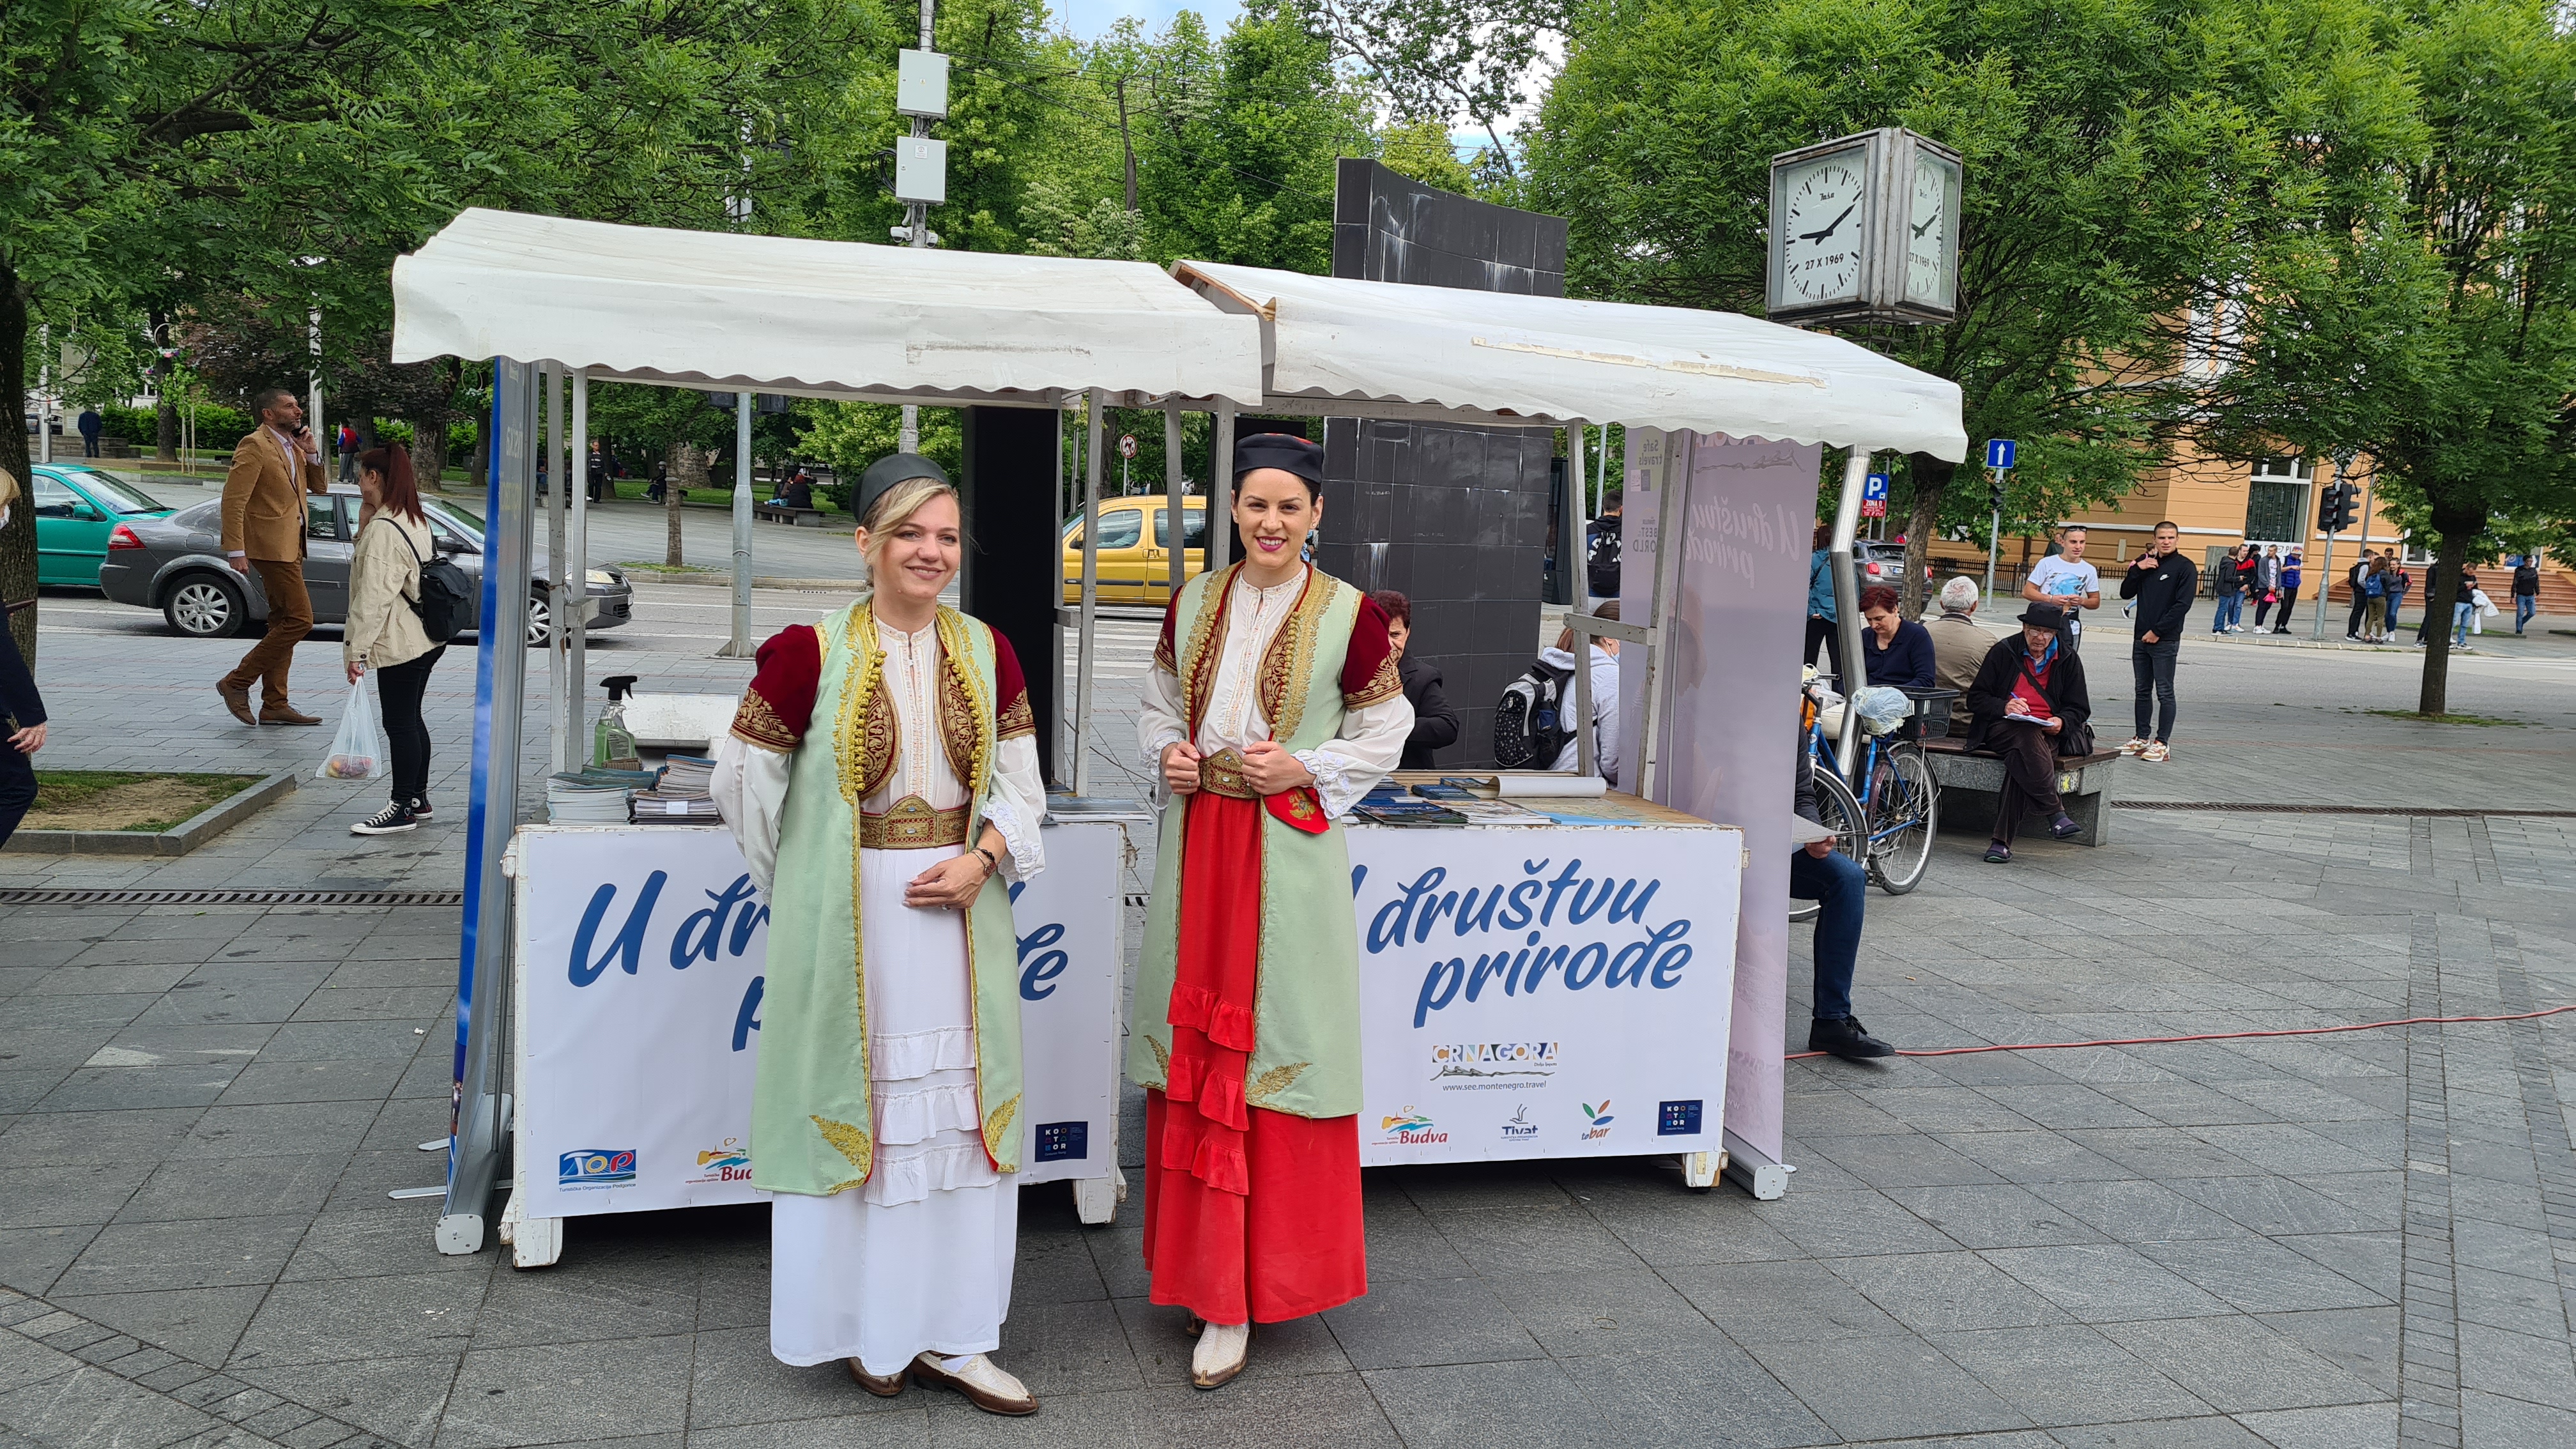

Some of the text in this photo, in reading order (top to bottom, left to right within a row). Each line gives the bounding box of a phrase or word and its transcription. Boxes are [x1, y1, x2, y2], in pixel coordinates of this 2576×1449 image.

[1805, 253, 1844, 270] 27 X 1969
[1920, 256, 1929, 268] 1969
[1868, 477, 1882, 496] P
[1367, 857, 1660, 954] društvu
[569, 870, 668, 987] U
[1413, 919, 1693, 1029] prirode
[1443, 1080, 1547, 1091] www.see.montenegro.travel
[1399, 1128, 1448, 1144] Budva
[1501, 1125, 1538, 1135] Tivat
